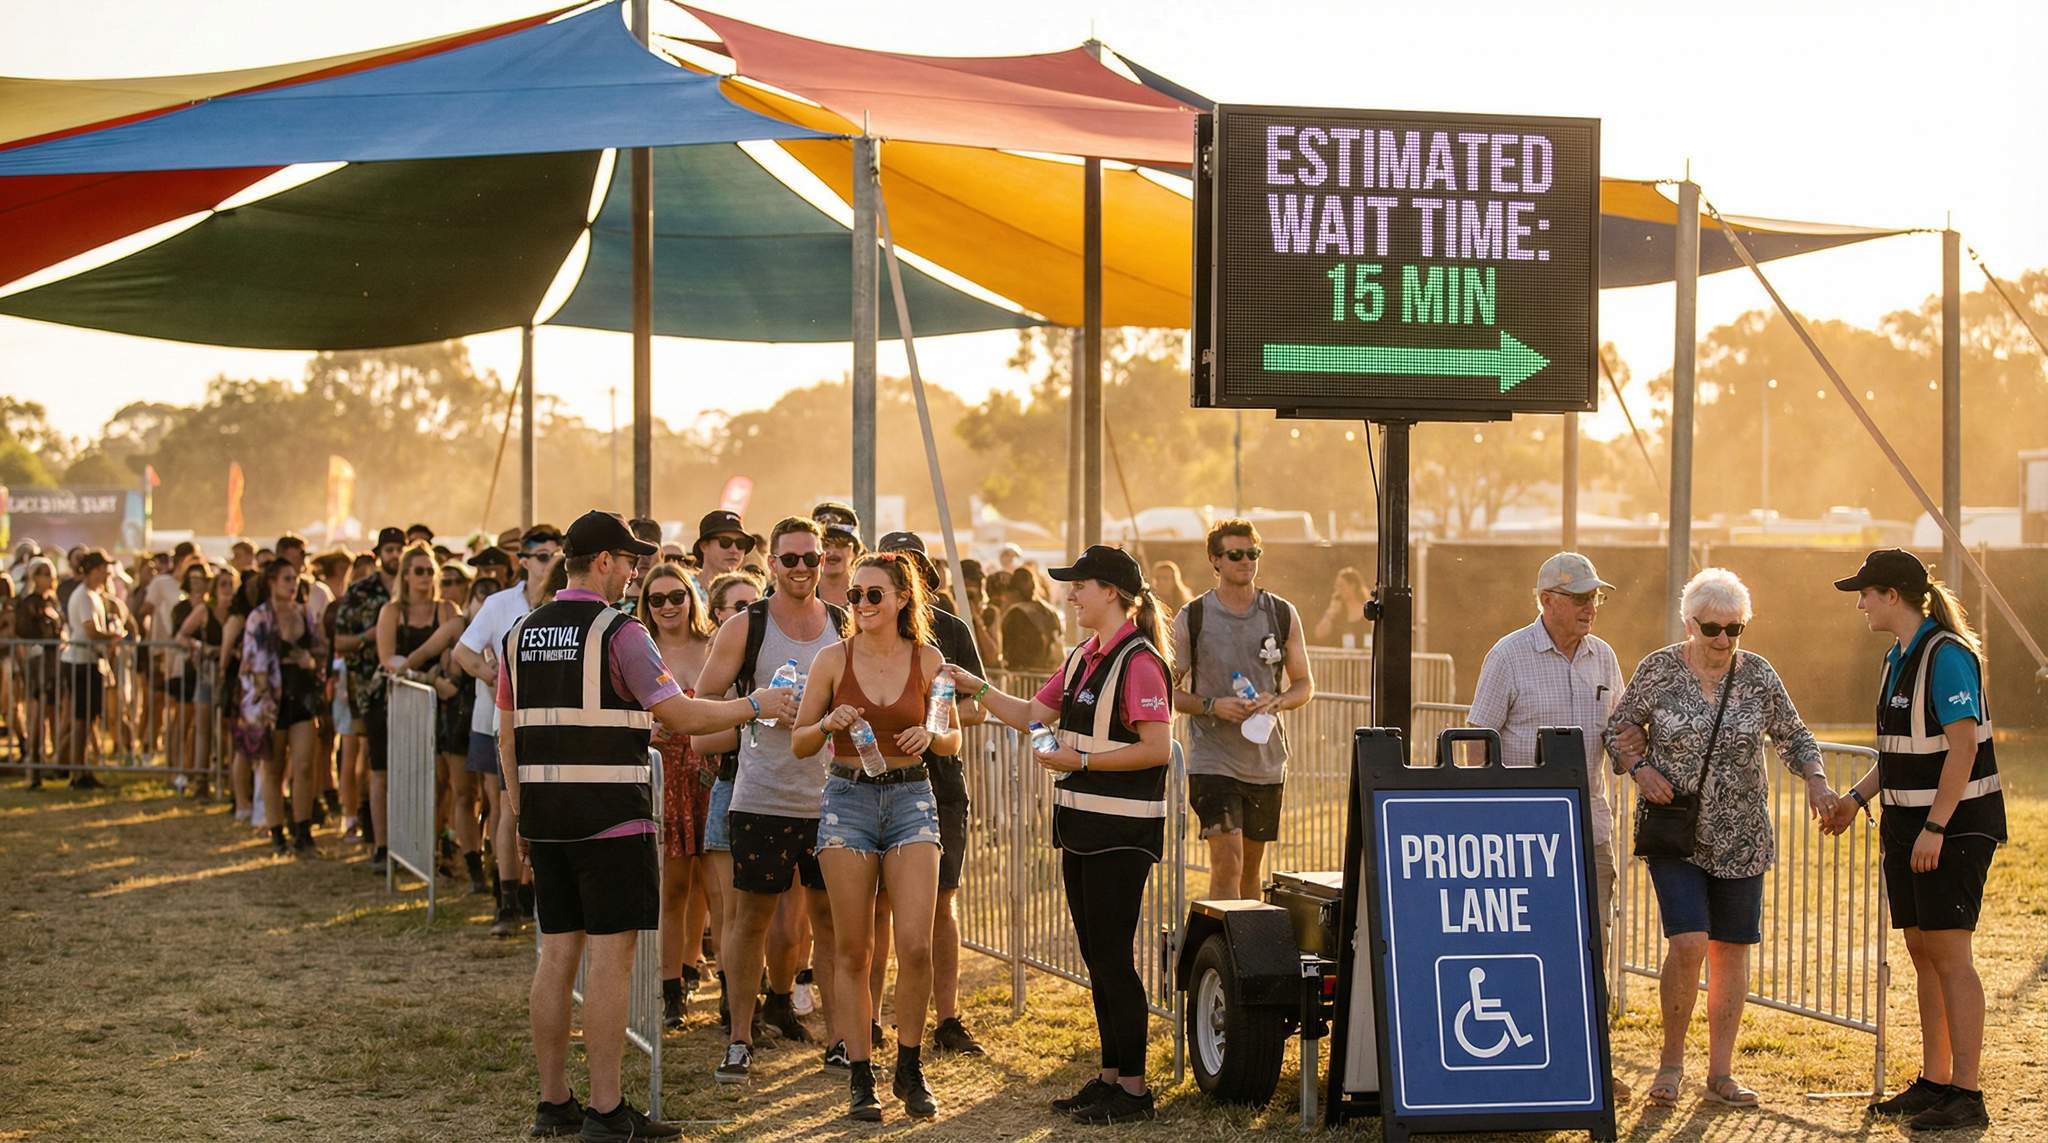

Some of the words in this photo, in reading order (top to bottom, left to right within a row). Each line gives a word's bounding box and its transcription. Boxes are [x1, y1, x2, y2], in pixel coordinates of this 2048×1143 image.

[1267, 126, 1553, 193] ESTIMATED
[1268, 194, 1398, 255] WAIT
[1412, 198, 1550, 261] TIME:
[1327, 263, 1385, 322] 15
[1401, 265, 1496, 325] MIN
[521, 626, 580, 648] FESTIVAL
[1401, 834, 1560, 879] PRIORITY
[1440, 888, 1531, 933] LANE
